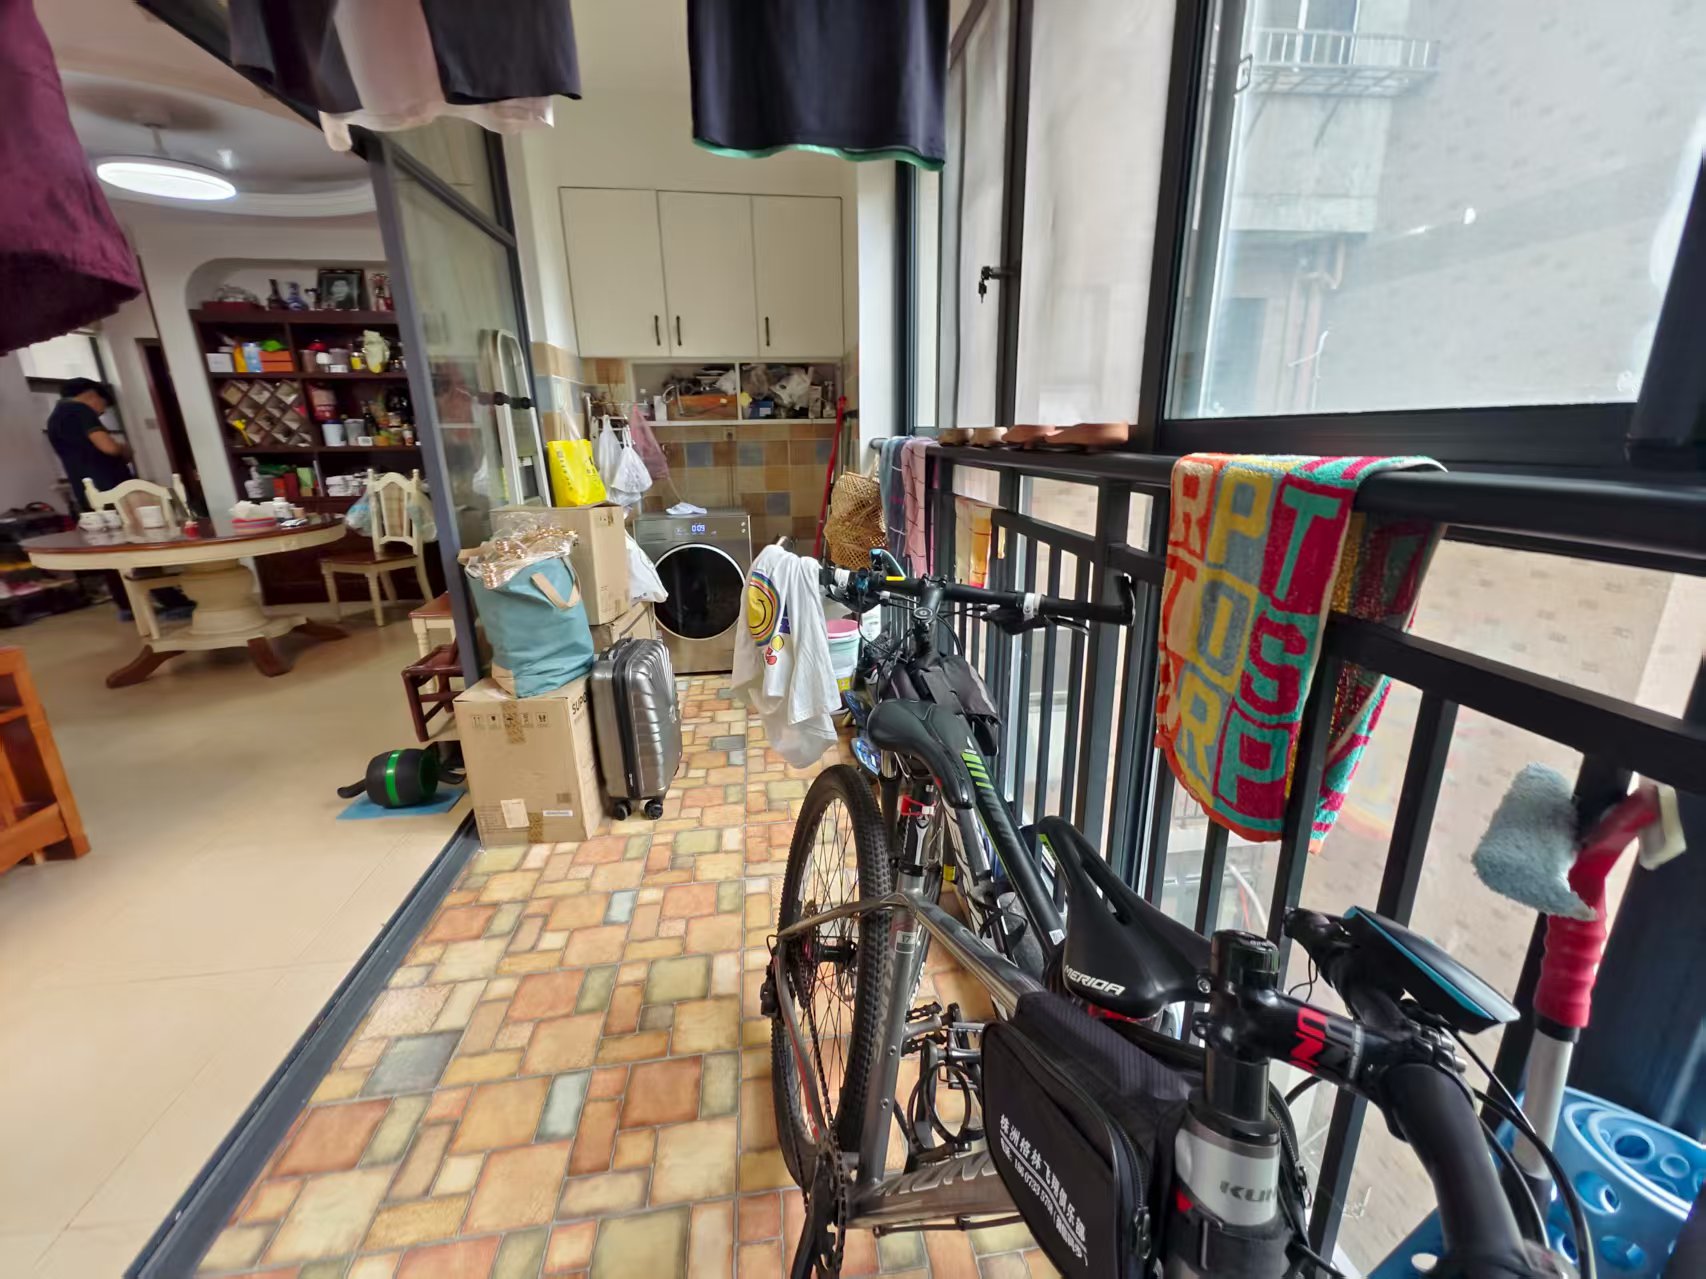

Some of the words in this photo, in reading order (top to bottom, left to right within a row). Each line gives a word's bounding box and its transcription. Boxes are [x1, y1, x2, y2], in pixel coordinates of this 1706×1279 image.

[1063, 964, 1126, 996] MERIDA
[1000, 1113, 1086, 1242] 株洲格林飞翔俱乐部
